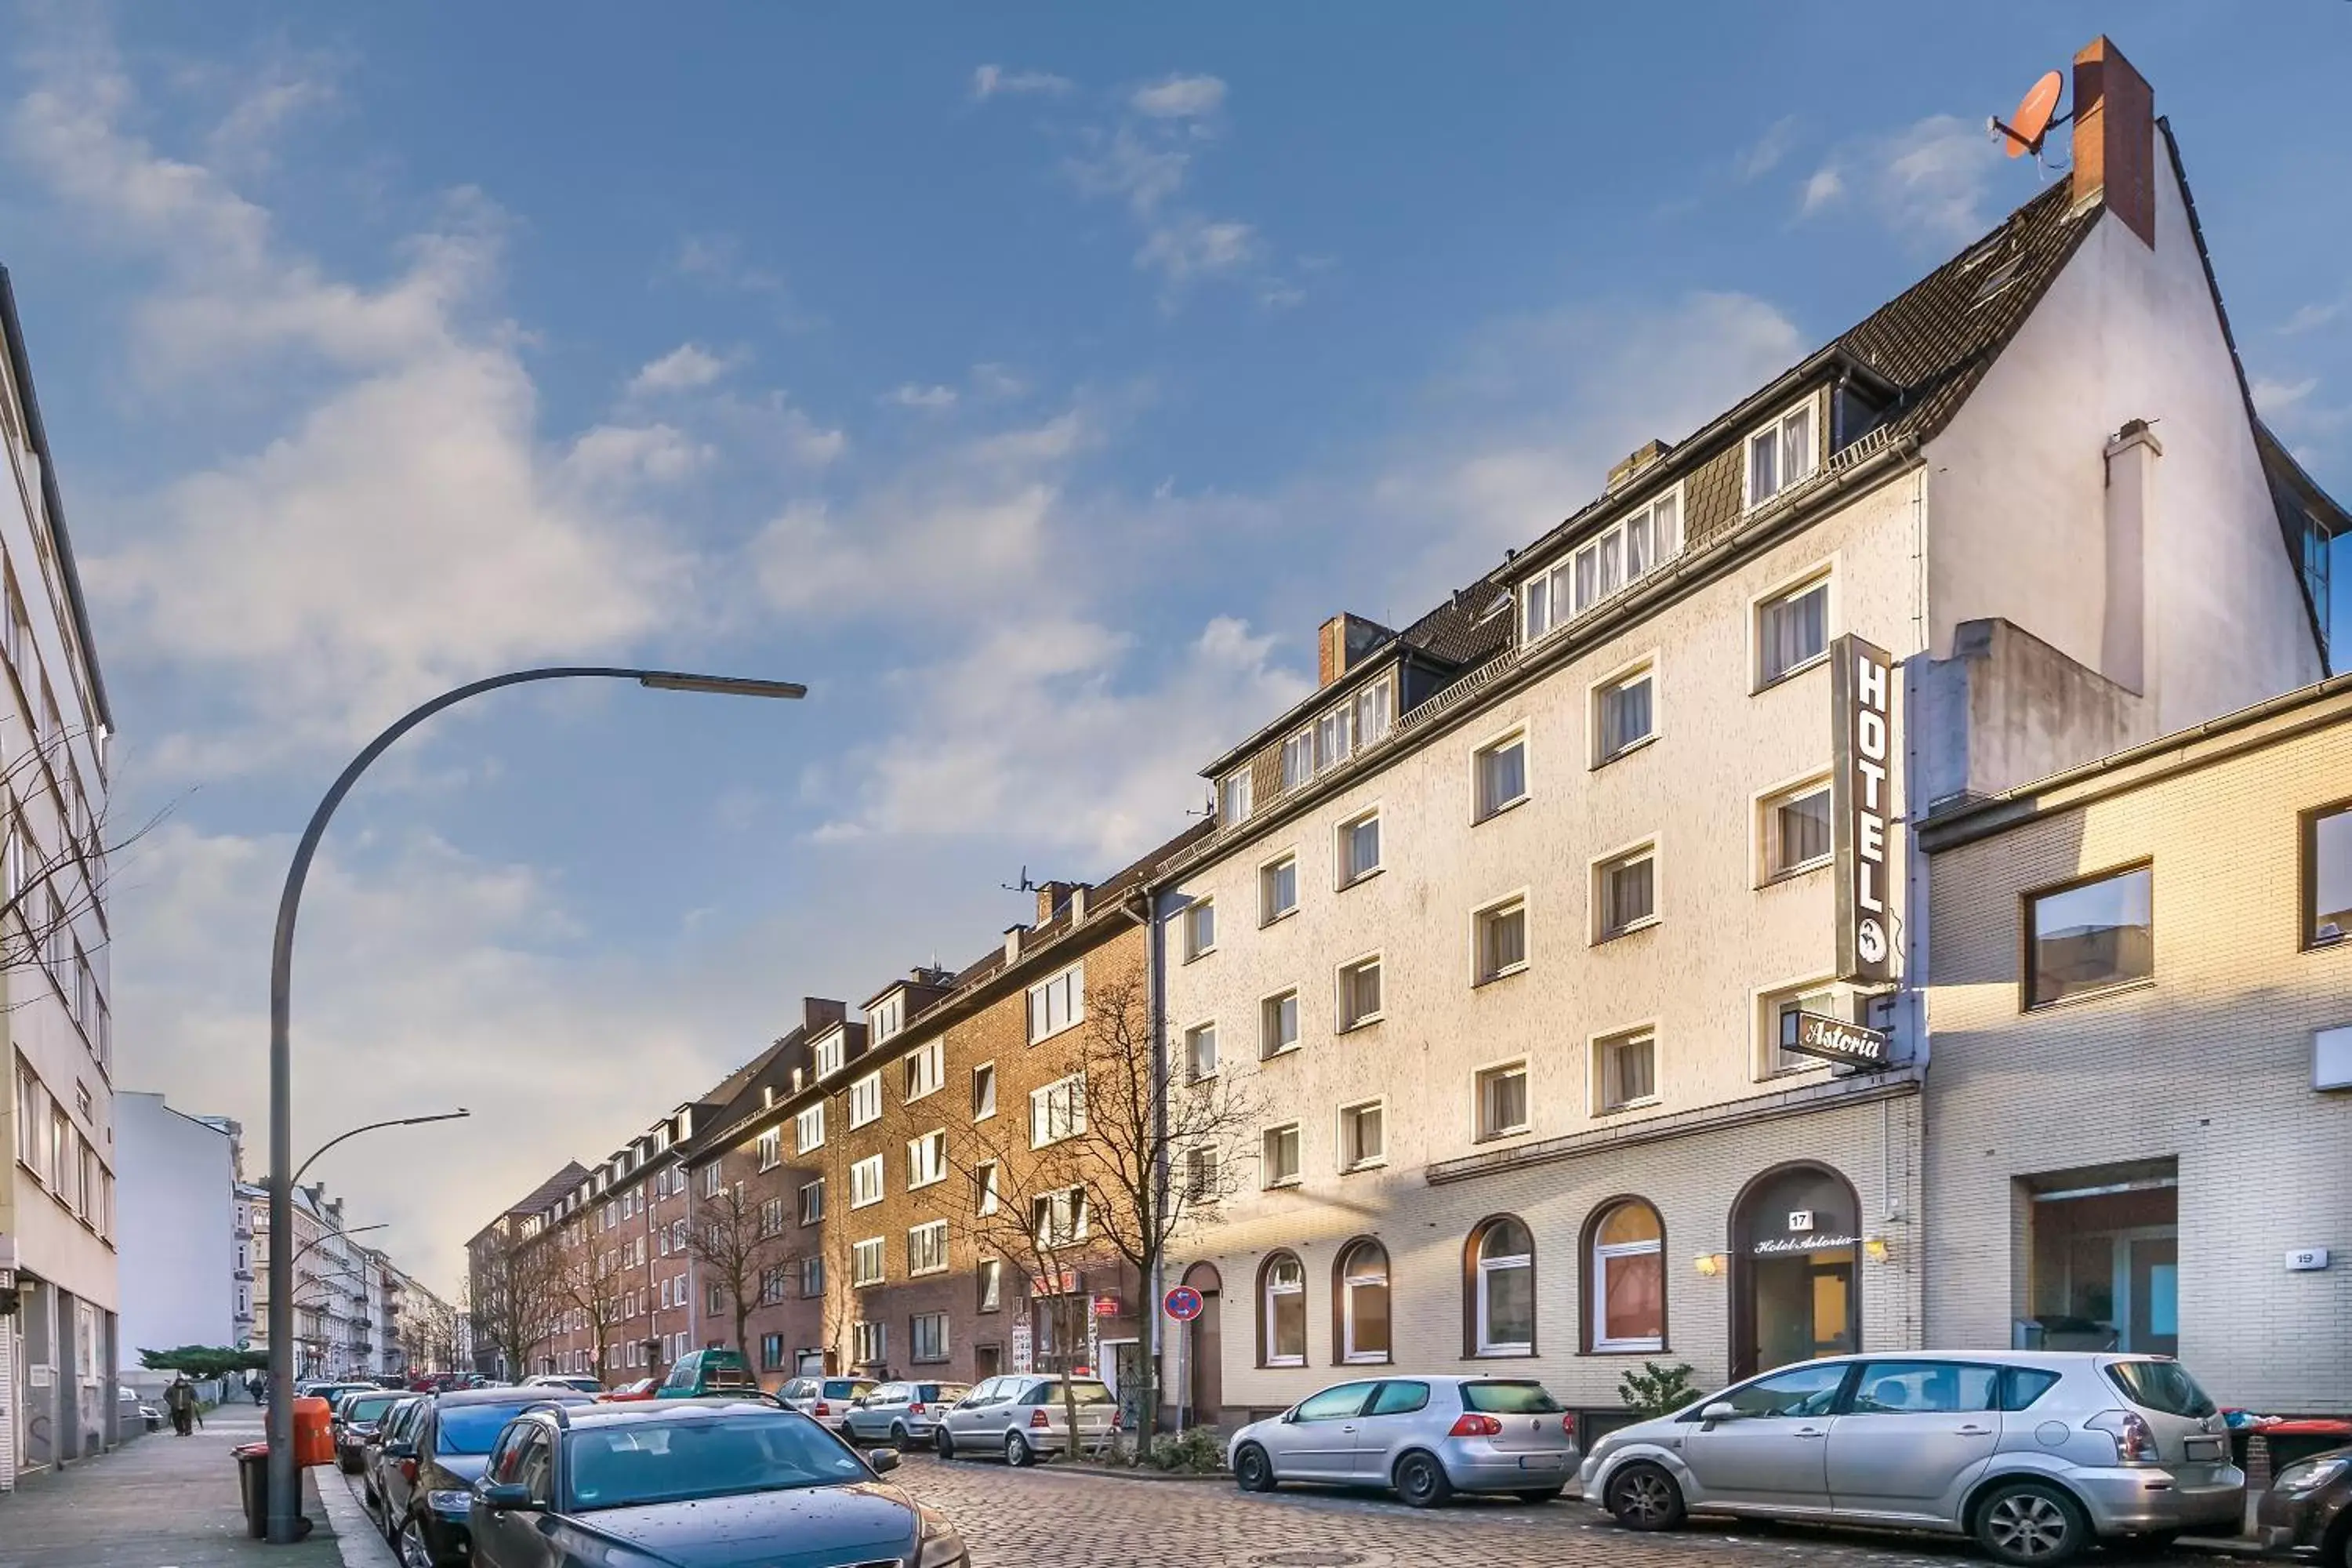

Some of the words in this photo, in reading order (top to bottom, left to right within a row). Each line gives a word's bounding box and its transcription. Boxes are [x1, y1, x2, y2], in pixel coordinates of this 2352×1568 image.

[1859, 655, 1886, 913] HOTEL
[1806, 1022, 1880, 1058] Astoria
[1791, 1214, 1806, 1227] 17
[1754, 1239, 1796, 1254] Hotel
[1796, 1236, 1853, 1249] Astoria
[2296, 1254, 2314, 1263] 19
